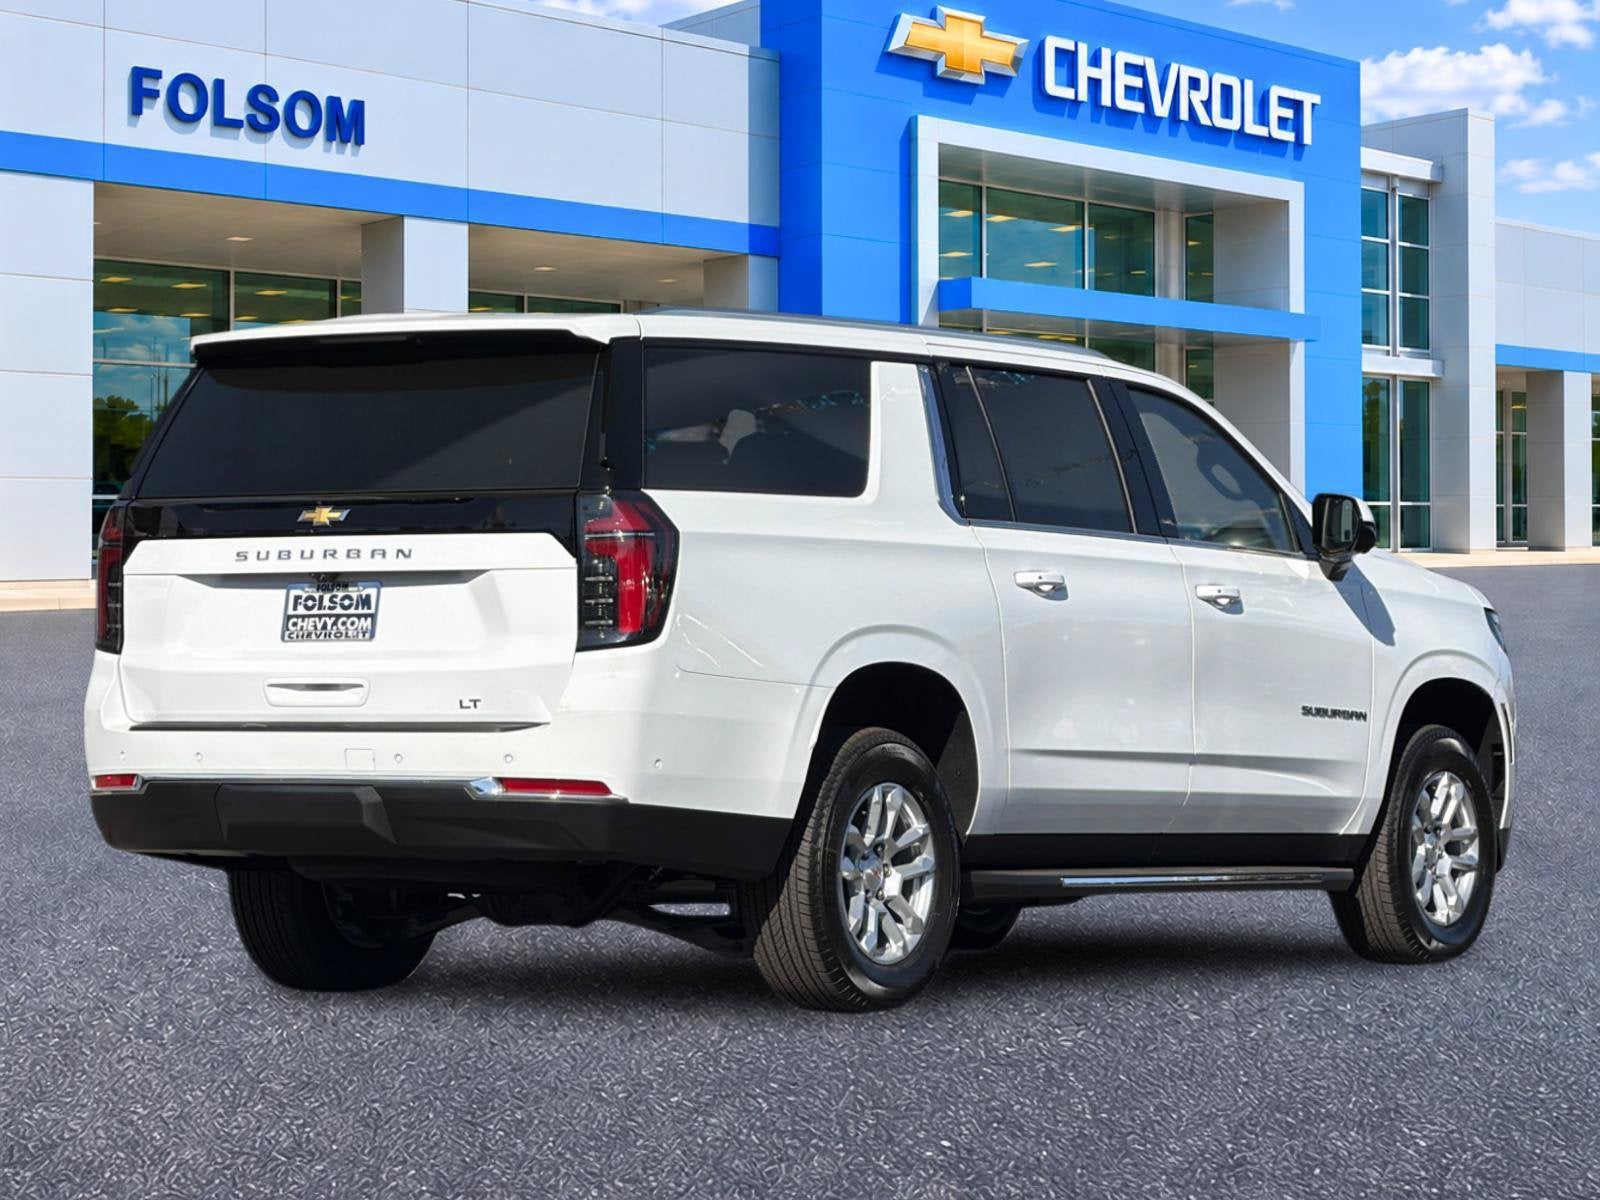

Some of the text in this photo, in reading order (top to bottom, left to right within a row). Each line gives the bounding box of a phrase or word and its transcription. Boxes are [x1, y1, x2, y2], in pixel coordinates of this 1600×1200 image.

[1044, 35, 1322, 145] CHEVROLET
[130, 65, 366, 145] FOLSOM
[235, 548, 413, 562] SUBURBAN
[316, 583, 349, 592] FOLSOM
[292, 594, 372, 611] FOLSOM
[287, 616, 372, 631] CHEVY.COM
[459, 699, 481, 709] LT
[1301, 705, 1367, 722] SUBURBAN
